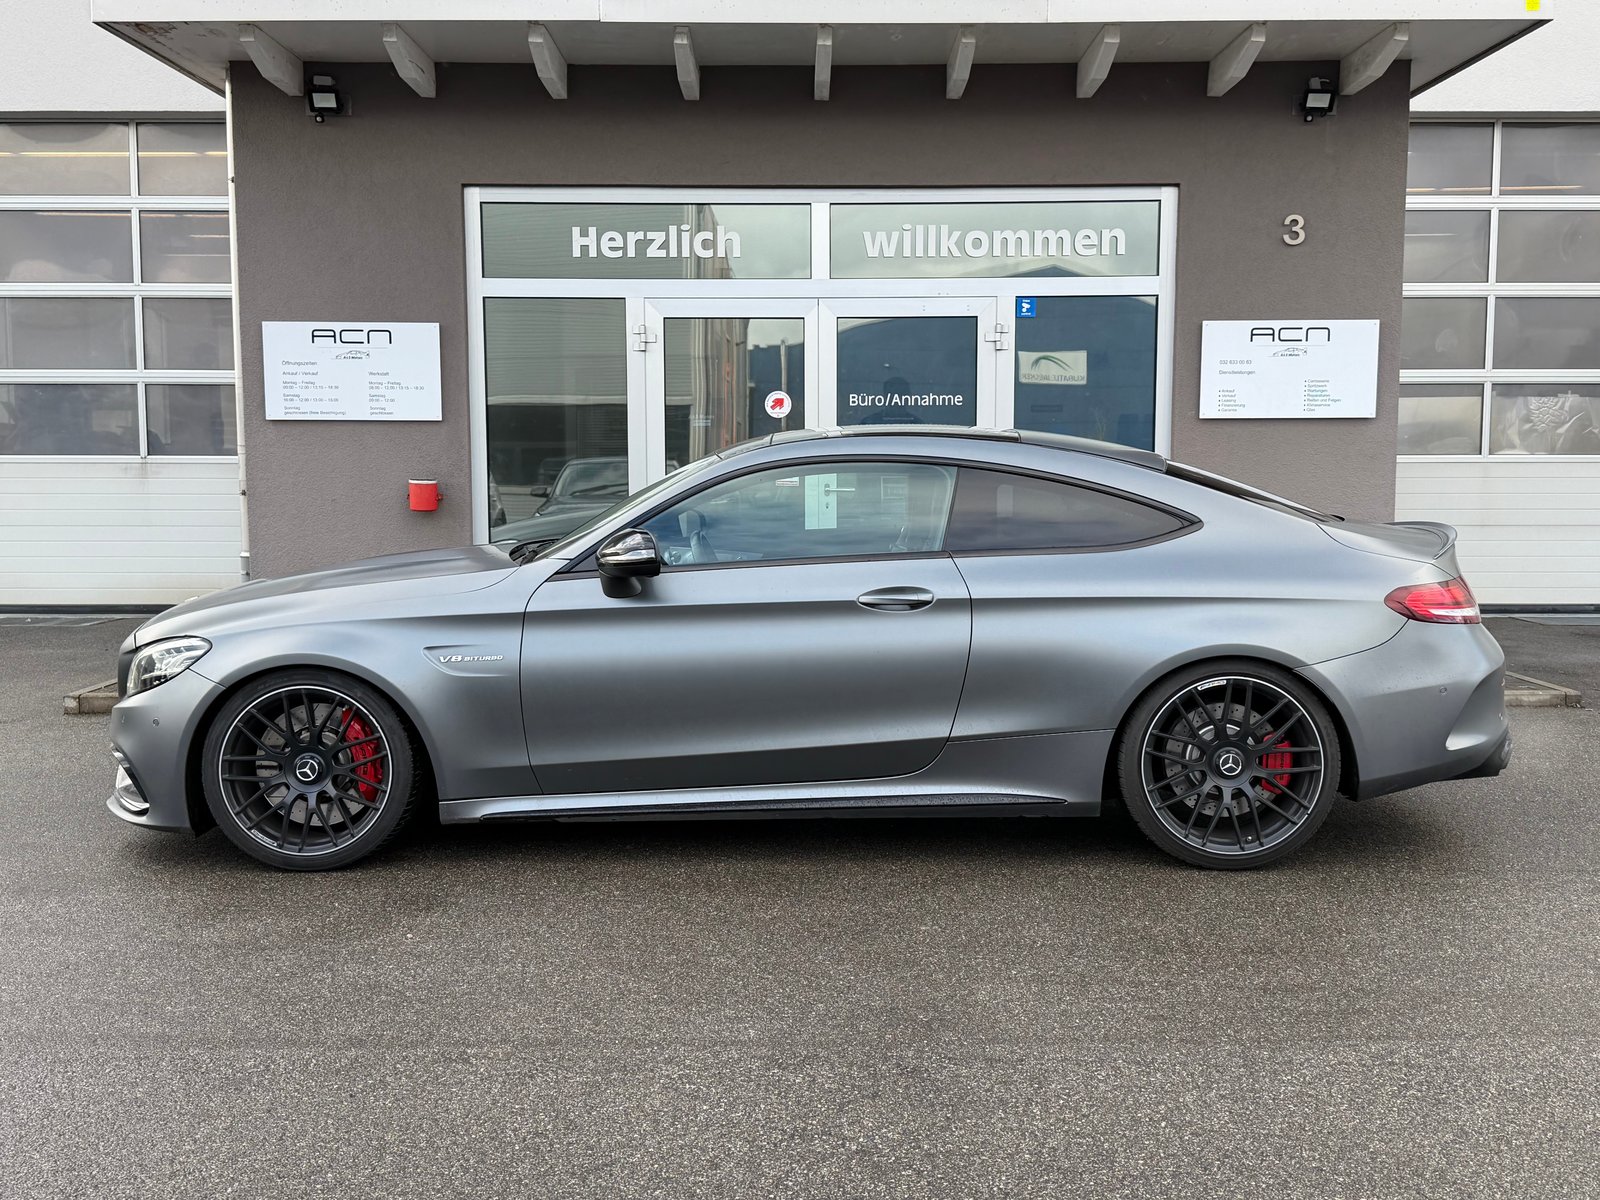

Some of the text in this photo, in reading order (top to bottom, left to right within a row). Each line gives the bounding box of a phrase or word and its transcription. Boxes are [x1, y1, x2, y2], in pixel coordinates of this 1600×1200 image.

[571, 224, 741, 258] Herzlich
[863, 223, 1127, 258] willkommen
[1282, 214, 1306, 246] 3
[849, 392, 963, 407] Büro/Annahme
[439, 655, 463, 663] V8
